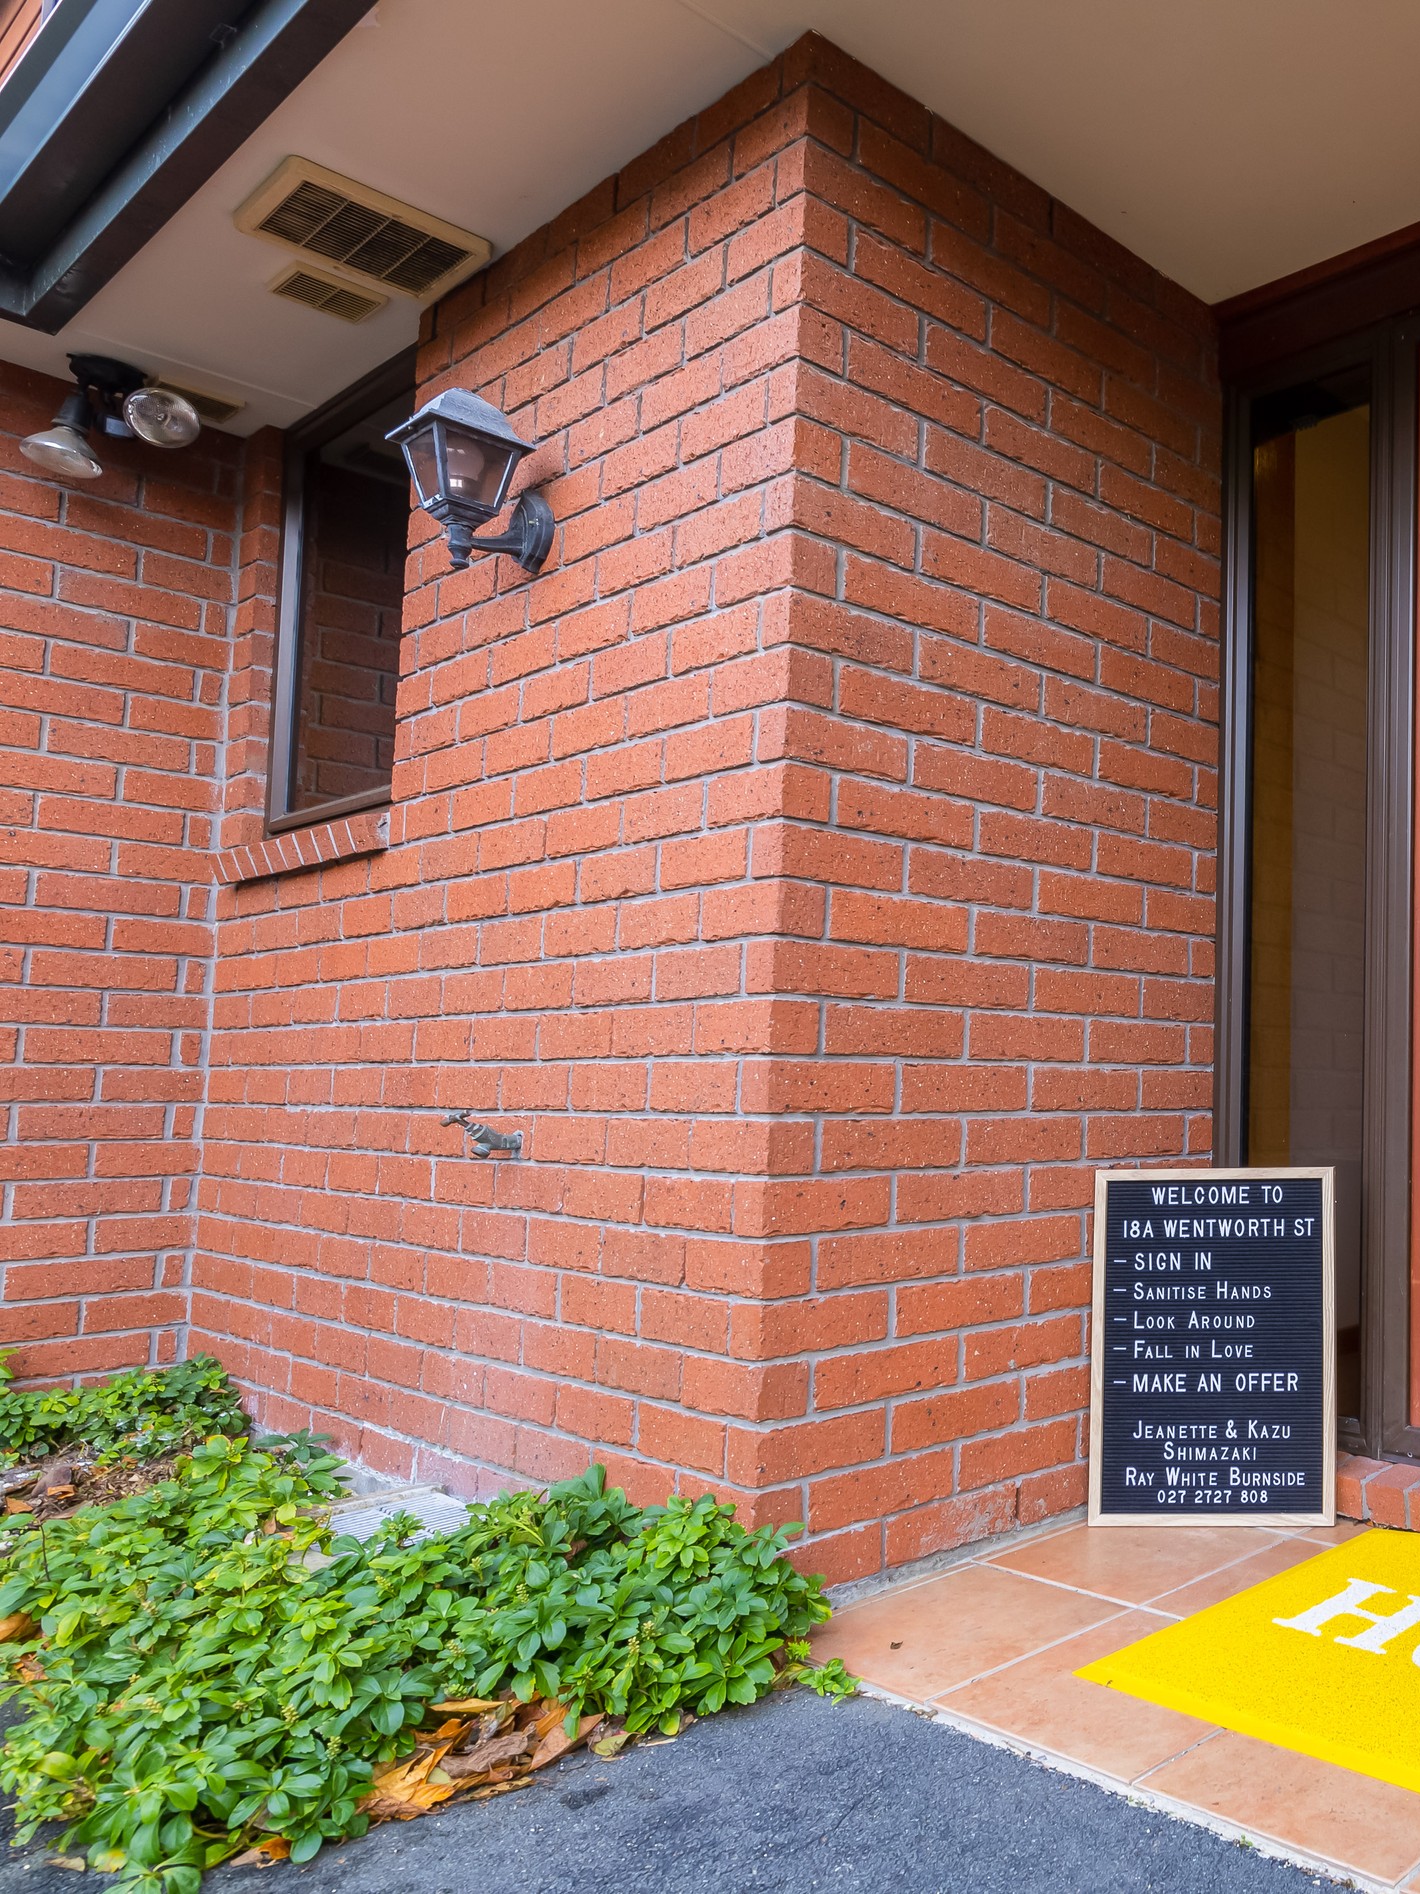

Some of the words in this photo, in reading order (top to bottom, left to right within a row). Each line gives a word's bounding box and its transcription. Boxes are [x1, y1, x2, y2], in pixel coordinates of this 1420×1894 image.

[1151, 1186, 1250, 1205] WELCOME
[1261, 1185, 1283, 1204] TO
[1123, 1219, 1154, 1238] 18A
[1163, 1218, 1285, 1238] WENTWORTH
[1293, 1218, 1315, 1237] ST
[1134, 1252, 1181, 1271] SIGN
[1194, 1251, 1212, 1270] IN
[1133, 1373, 1187, 1393] MAKE
[1197, 1373, 1222, 1393] AN
[1235, 1372, 1299, 1392] OFFER
[1225, 1419, 1238, 1439] &
[1157, 1489, 1187, 1504] 027
[1194, 1489, 1232, 1504] 2727
[1240, 1489, 1268, 1504] 808
